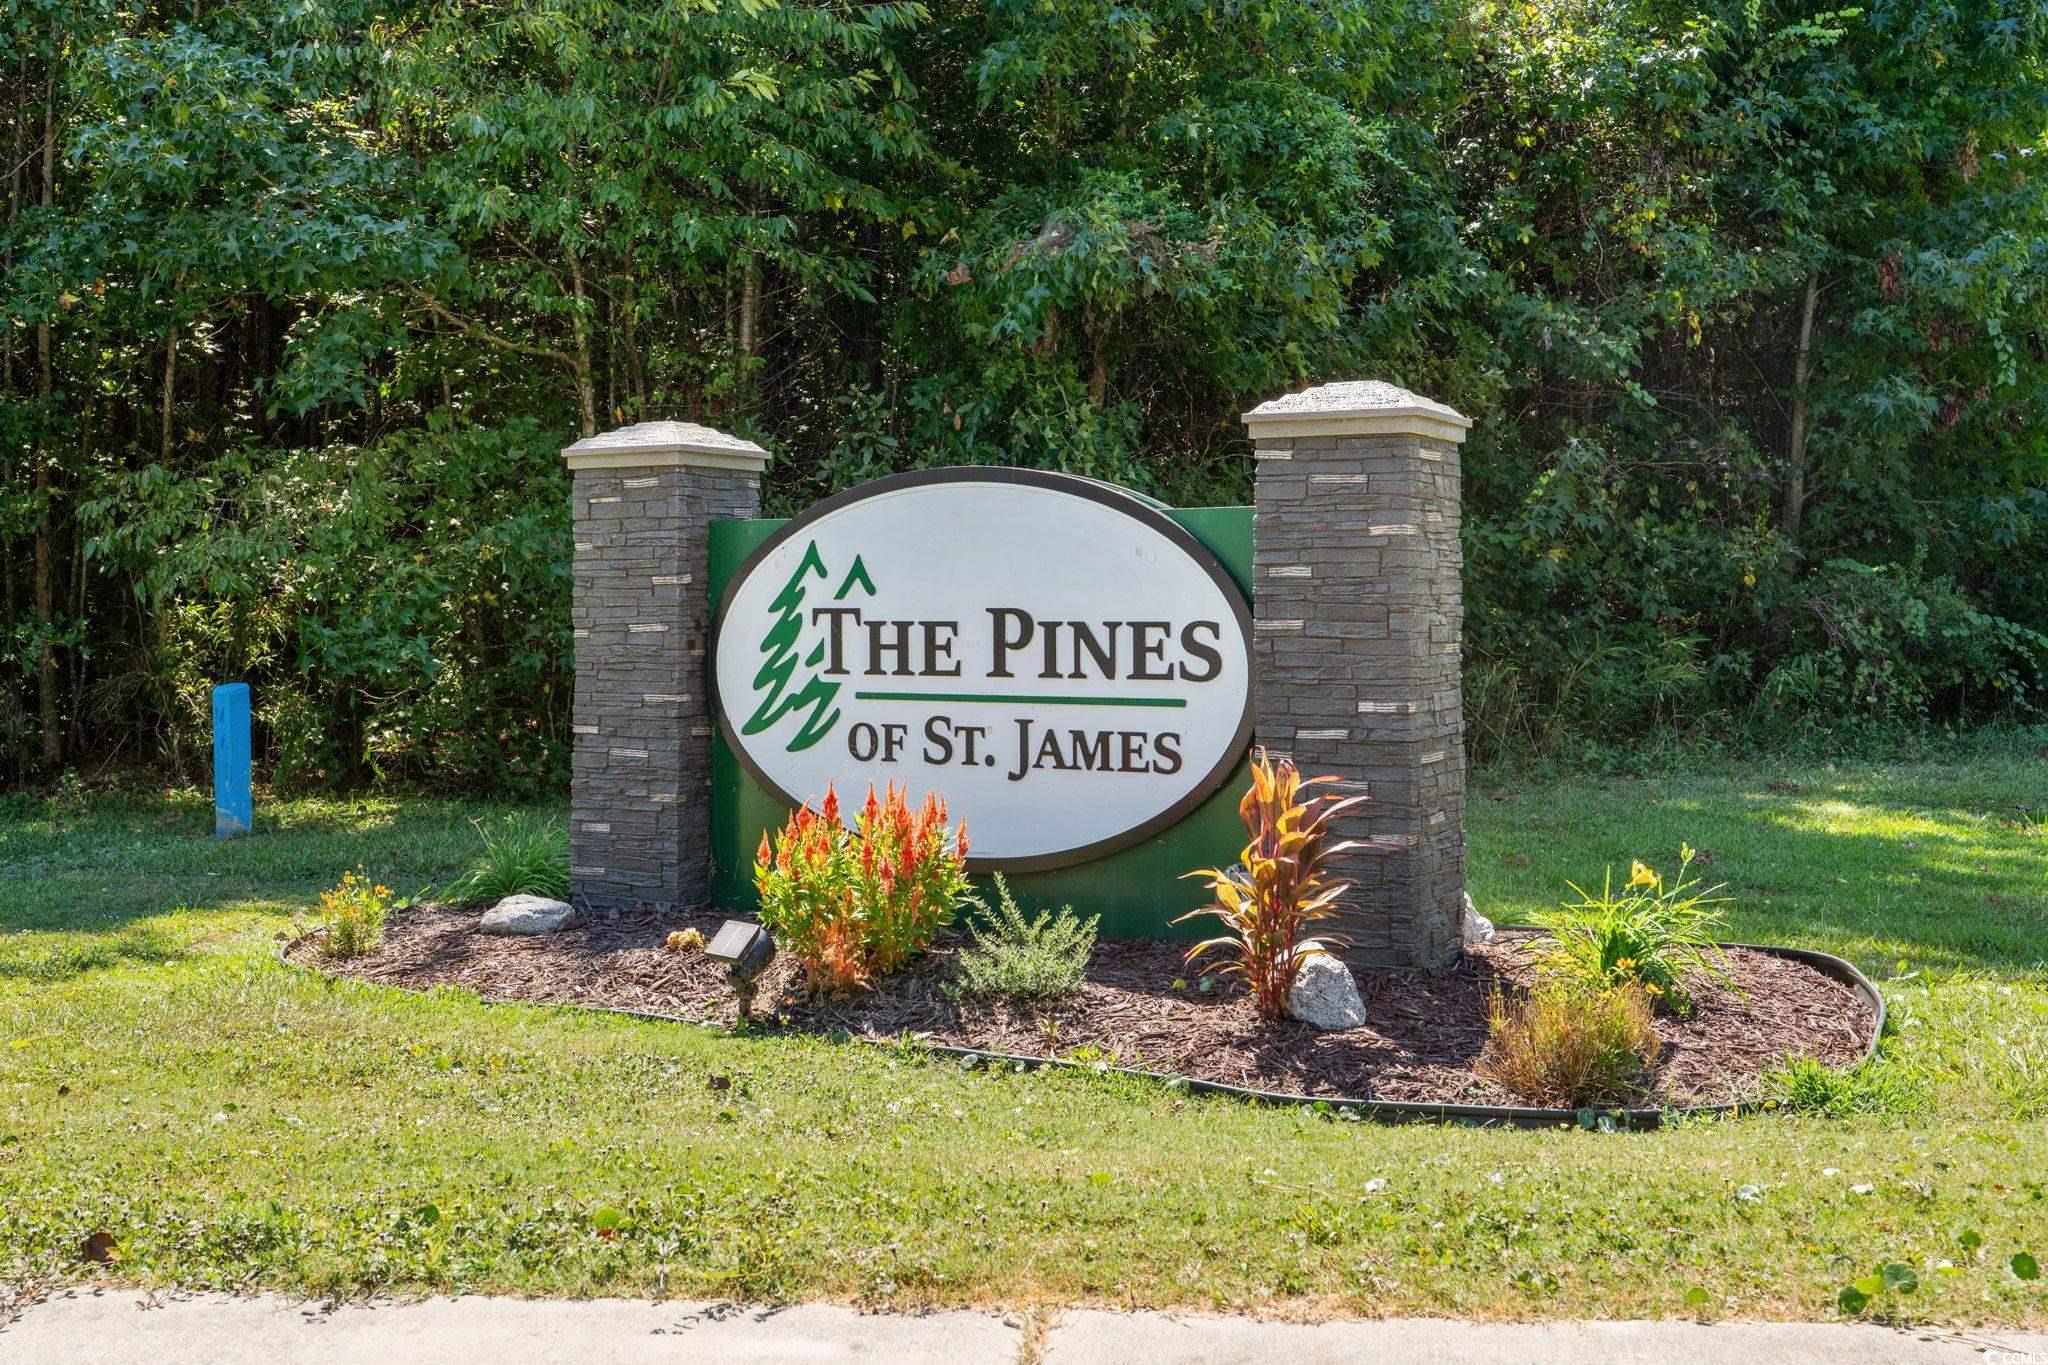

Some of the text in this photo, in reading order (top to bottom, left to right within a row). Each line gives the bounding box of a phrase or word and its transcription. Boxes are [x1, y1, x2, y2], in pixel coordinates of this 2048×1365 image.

[812, 607, 1223, 682] THE PINES
[848, 715, 1183, 782] OF ST. JAMES
